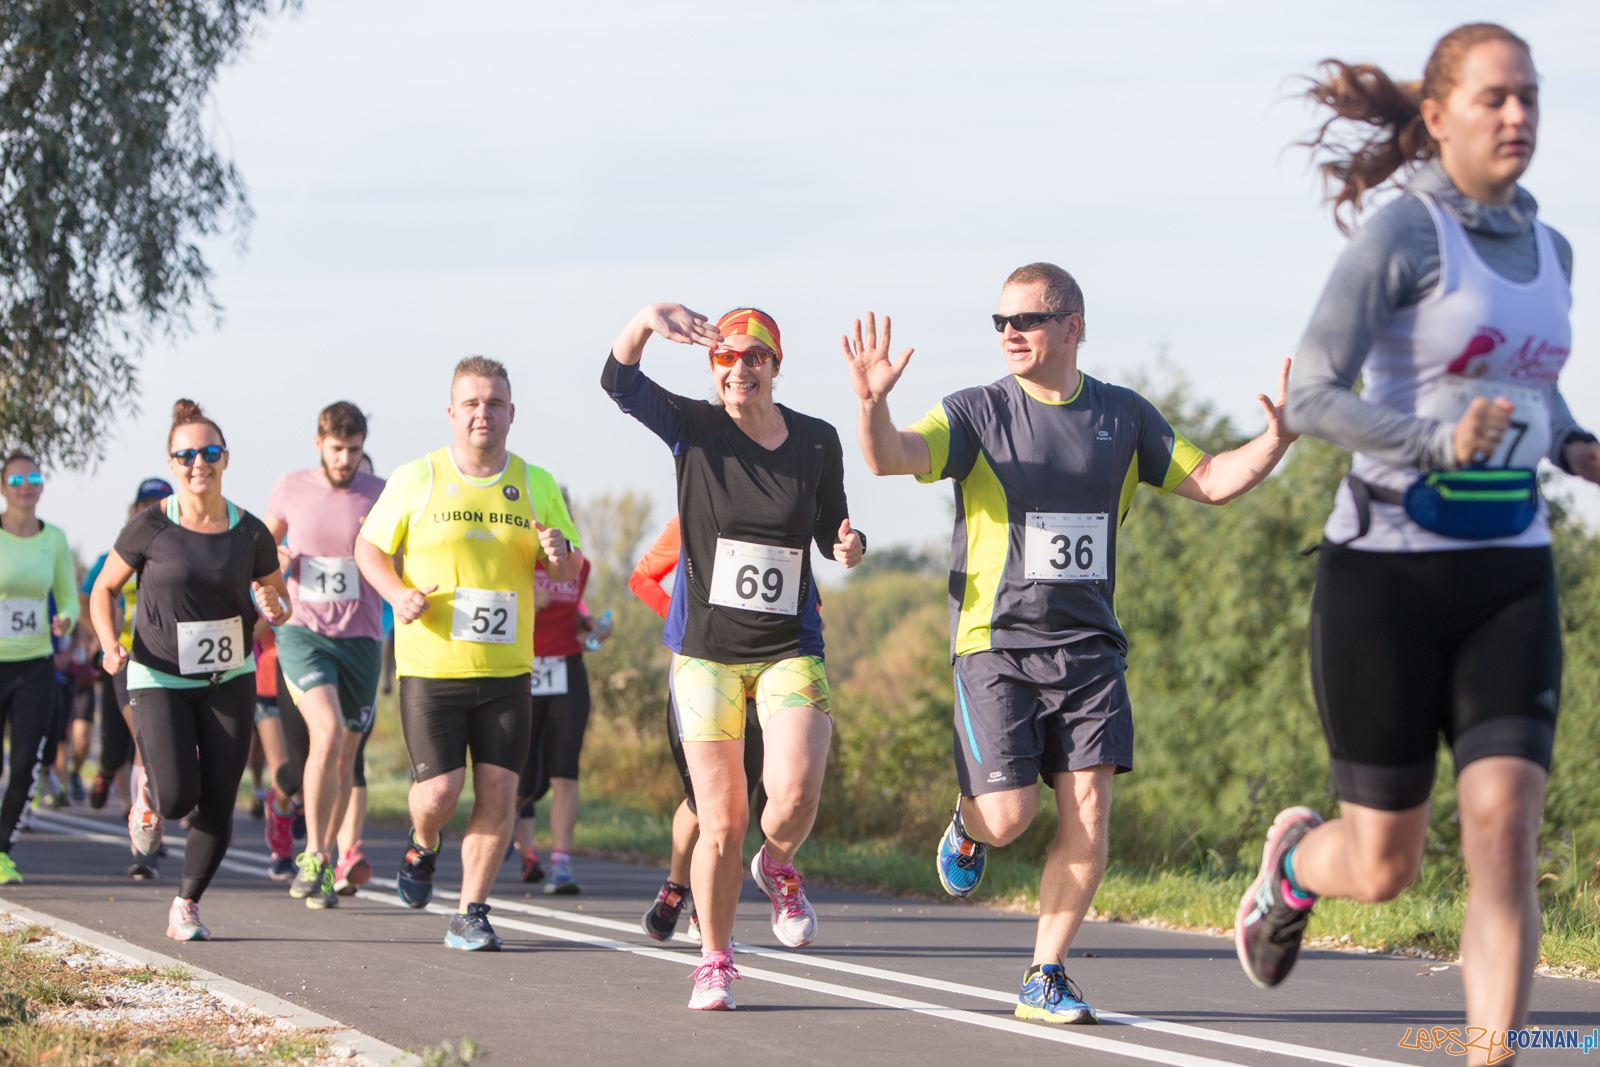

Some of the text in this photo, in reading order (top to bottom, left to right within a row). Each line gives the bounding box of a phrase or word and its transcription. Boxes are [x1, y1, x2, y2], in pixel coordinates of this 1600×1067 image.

[433, 508, 531, 530] LUBOŃ BIEGA
[1049, 534, 1094, 571] 36
[315, 571, 347, 594] 13
[735, 564, 784, 603] 69
[11, 610, 37, 632] 54
[471, 606, 508, 636] 52
[197, 635, 233, 665] 28
